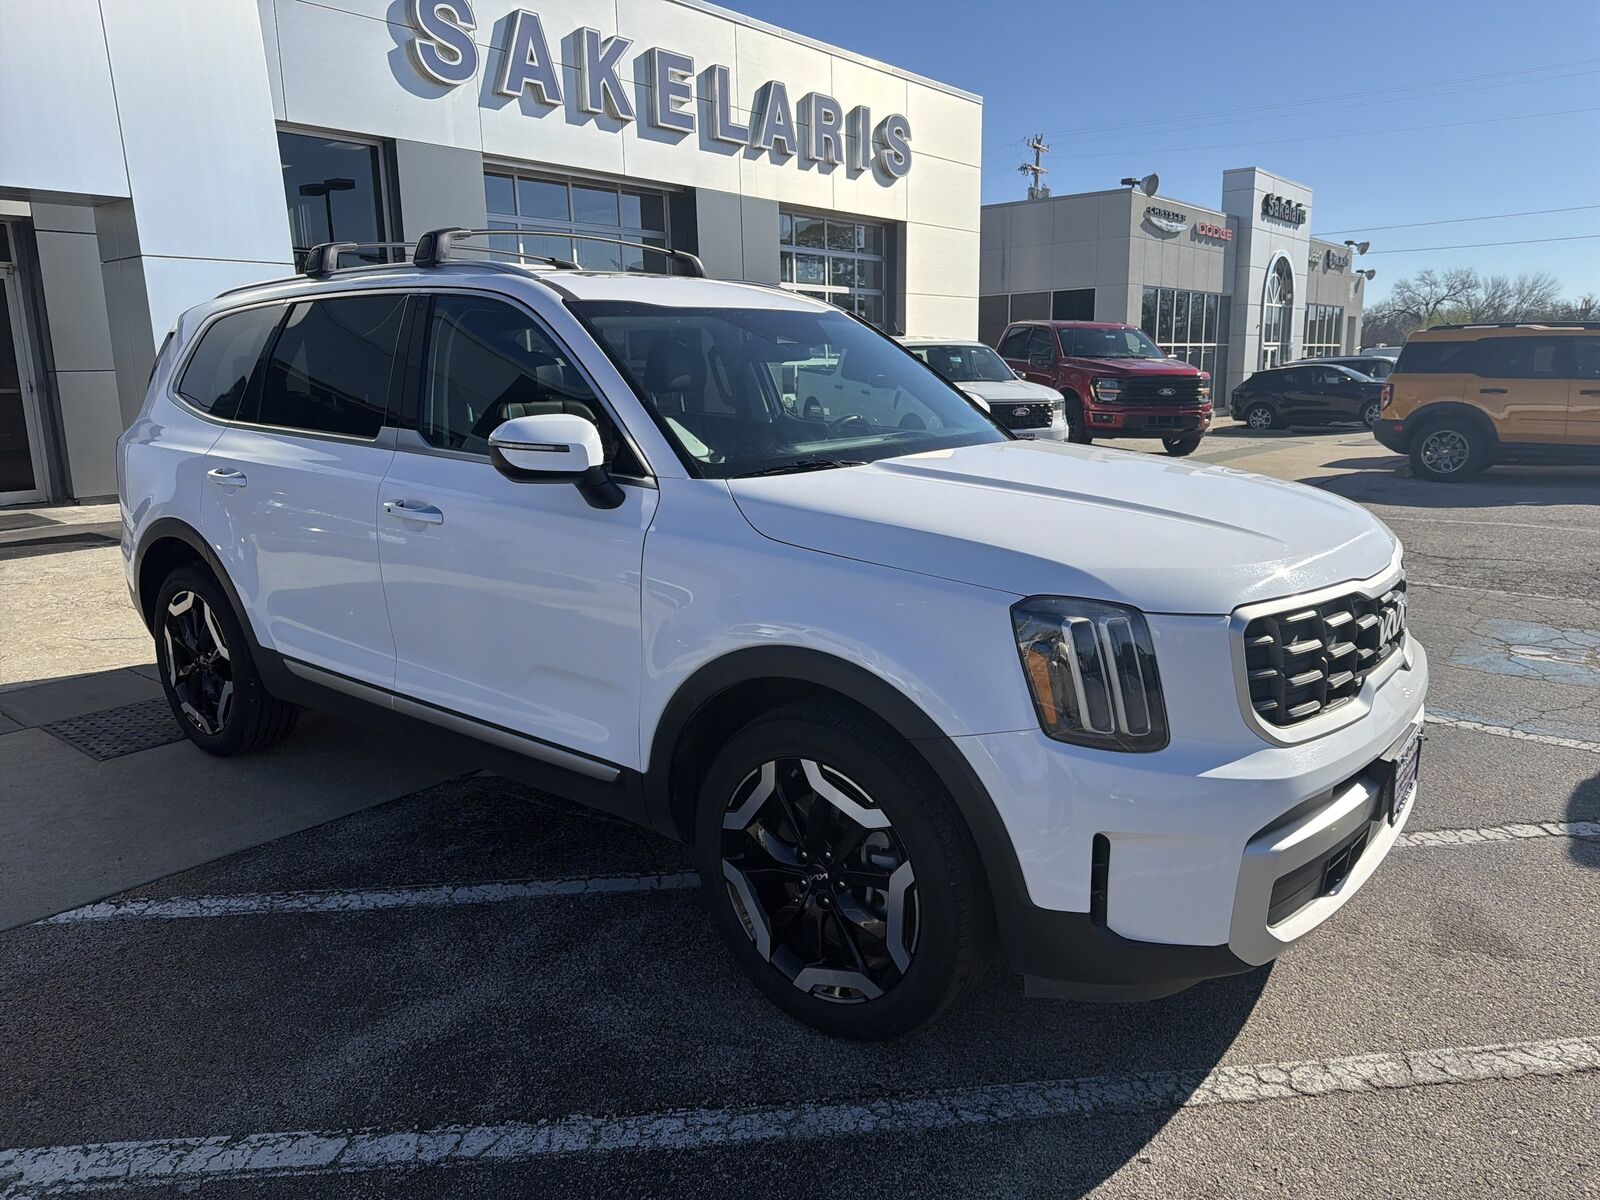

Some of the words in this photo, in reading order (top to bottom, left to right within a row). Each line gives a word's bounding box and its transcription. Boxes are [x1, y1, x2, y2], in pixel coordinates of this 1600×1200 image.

[410, 0, 913, 178] SAKELARIS
[1267, 193, 1306, 224] Sakelaris
[1198, 223, 1233, 240] DODGE
